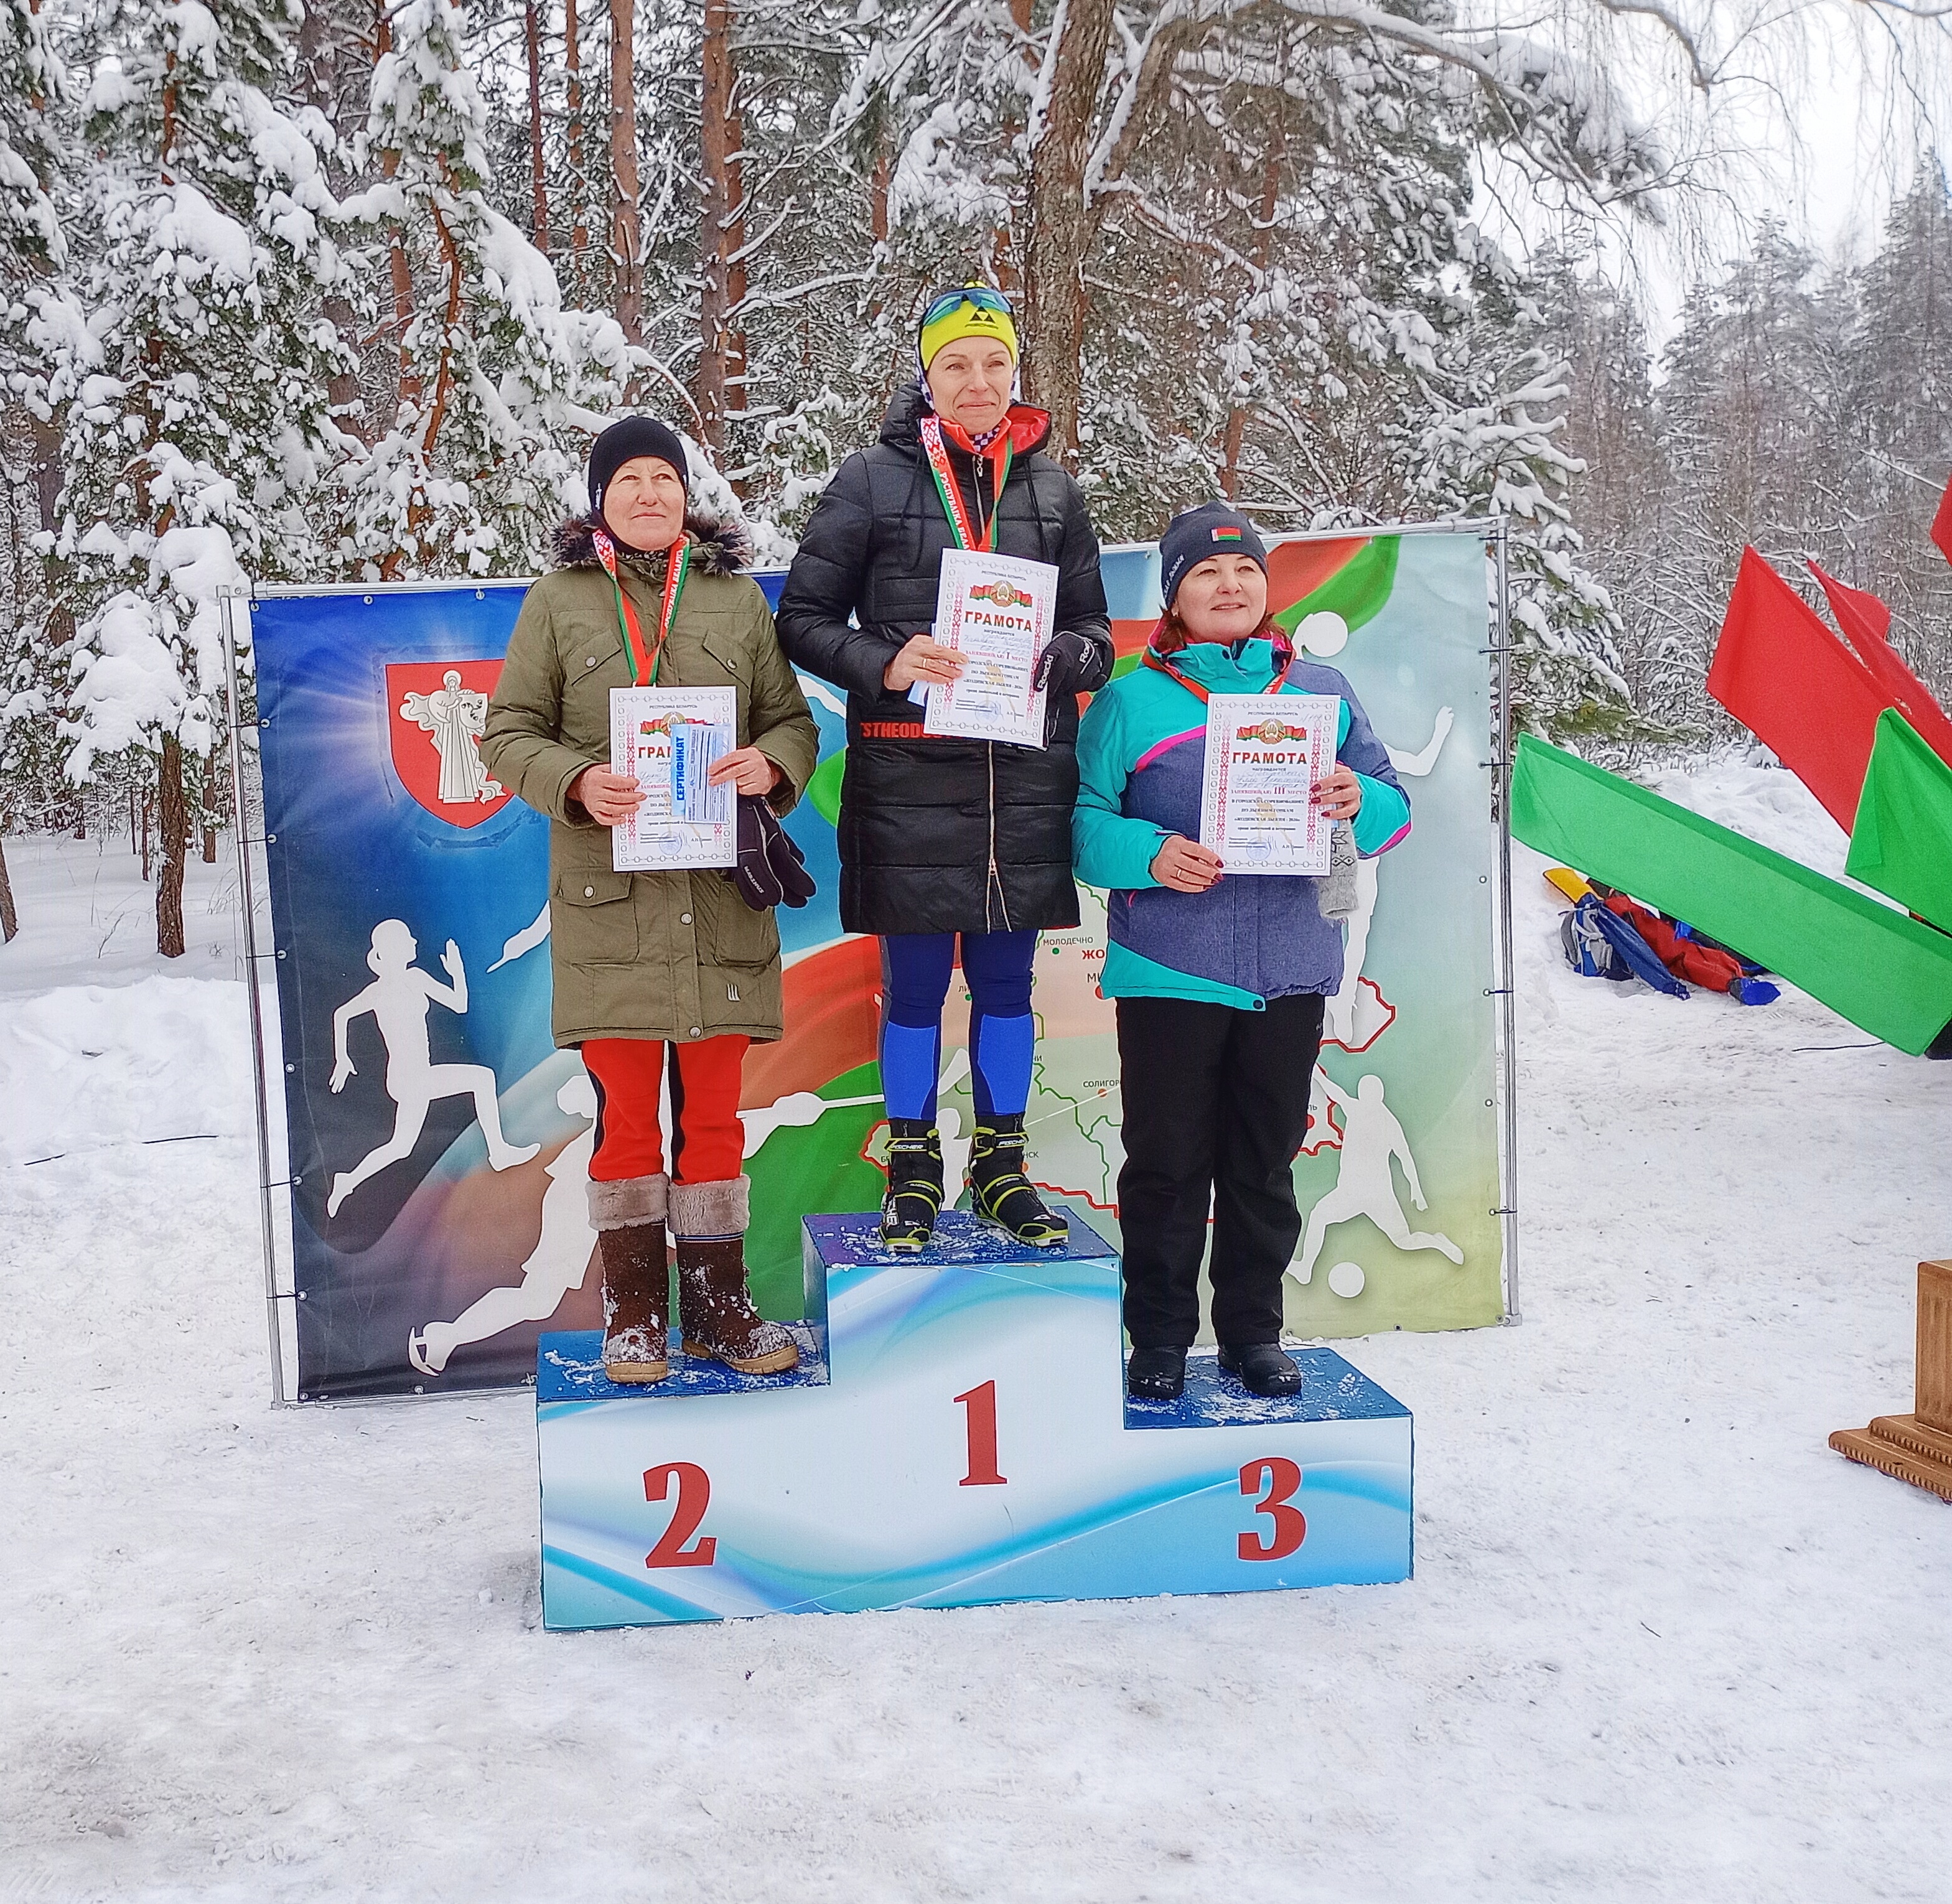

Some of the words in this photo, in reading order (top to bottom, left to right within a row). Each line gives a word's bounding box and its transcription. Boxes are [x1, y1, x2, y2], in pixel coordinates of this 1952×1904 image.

[964, 611, 1032, 633] ГРАМОТА
[638, 746, 671, 758] ГРА
[1232, 752, 1307, 764] ГРАМОТА
[676, 736, 684, 801] СЕРТИФИКАТ
[1043, 936, 1093, 946] МОЛОДЕЧНО
[1083, 1080, 1119, 1088] СОЛИГОР
[954, 1379, 1007, 1486] 1
[643, 1462, 717, 1569] 2
[1238, 1457, 1306, 1561] 3
